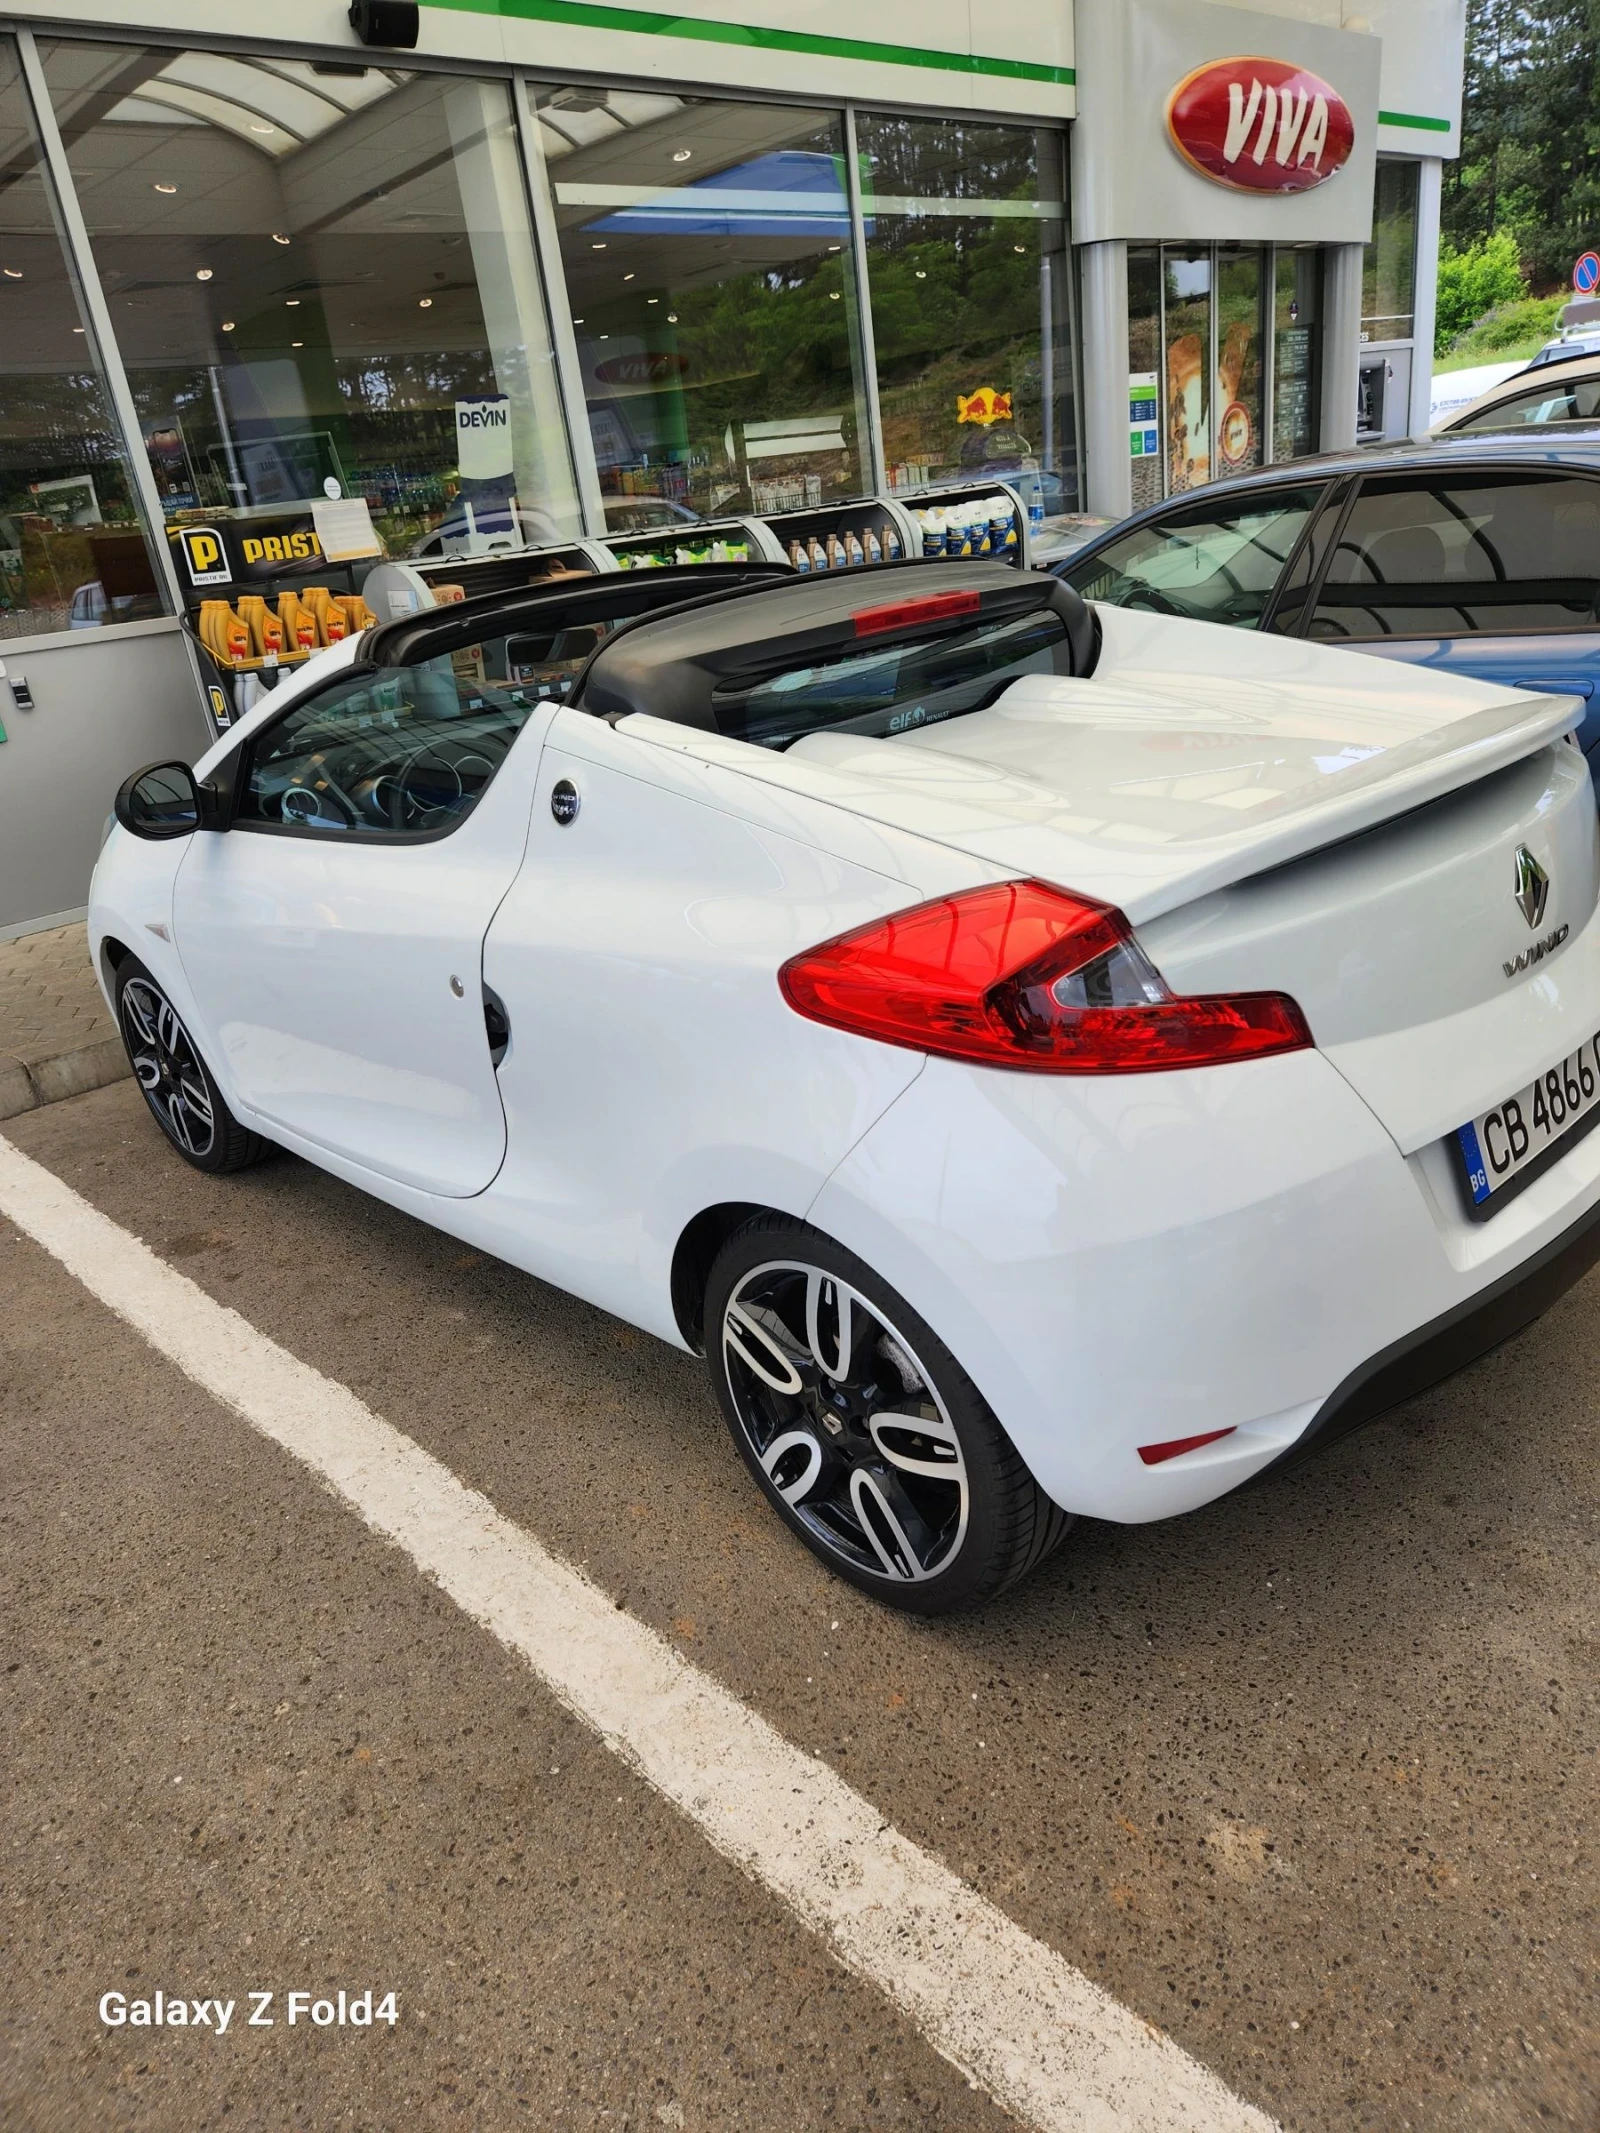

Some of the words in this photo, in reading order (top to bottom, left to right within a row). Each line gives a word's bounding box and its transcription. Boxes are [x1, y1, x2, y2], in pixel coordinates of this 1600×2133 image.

[1223, 77, 1328, 171] VIVA
[619, 360, 668, 379] VIVA
[459, 408, 507, 428] DEVIN
[889, 711, 912, 730] elf
[1502, 923, 1569, 978] WIND
[1483, 1098, 1529, 1174] CB
[1532, 1048, 1595, 1136] 4866
[1469, 1169, 1486, 1193] BG
